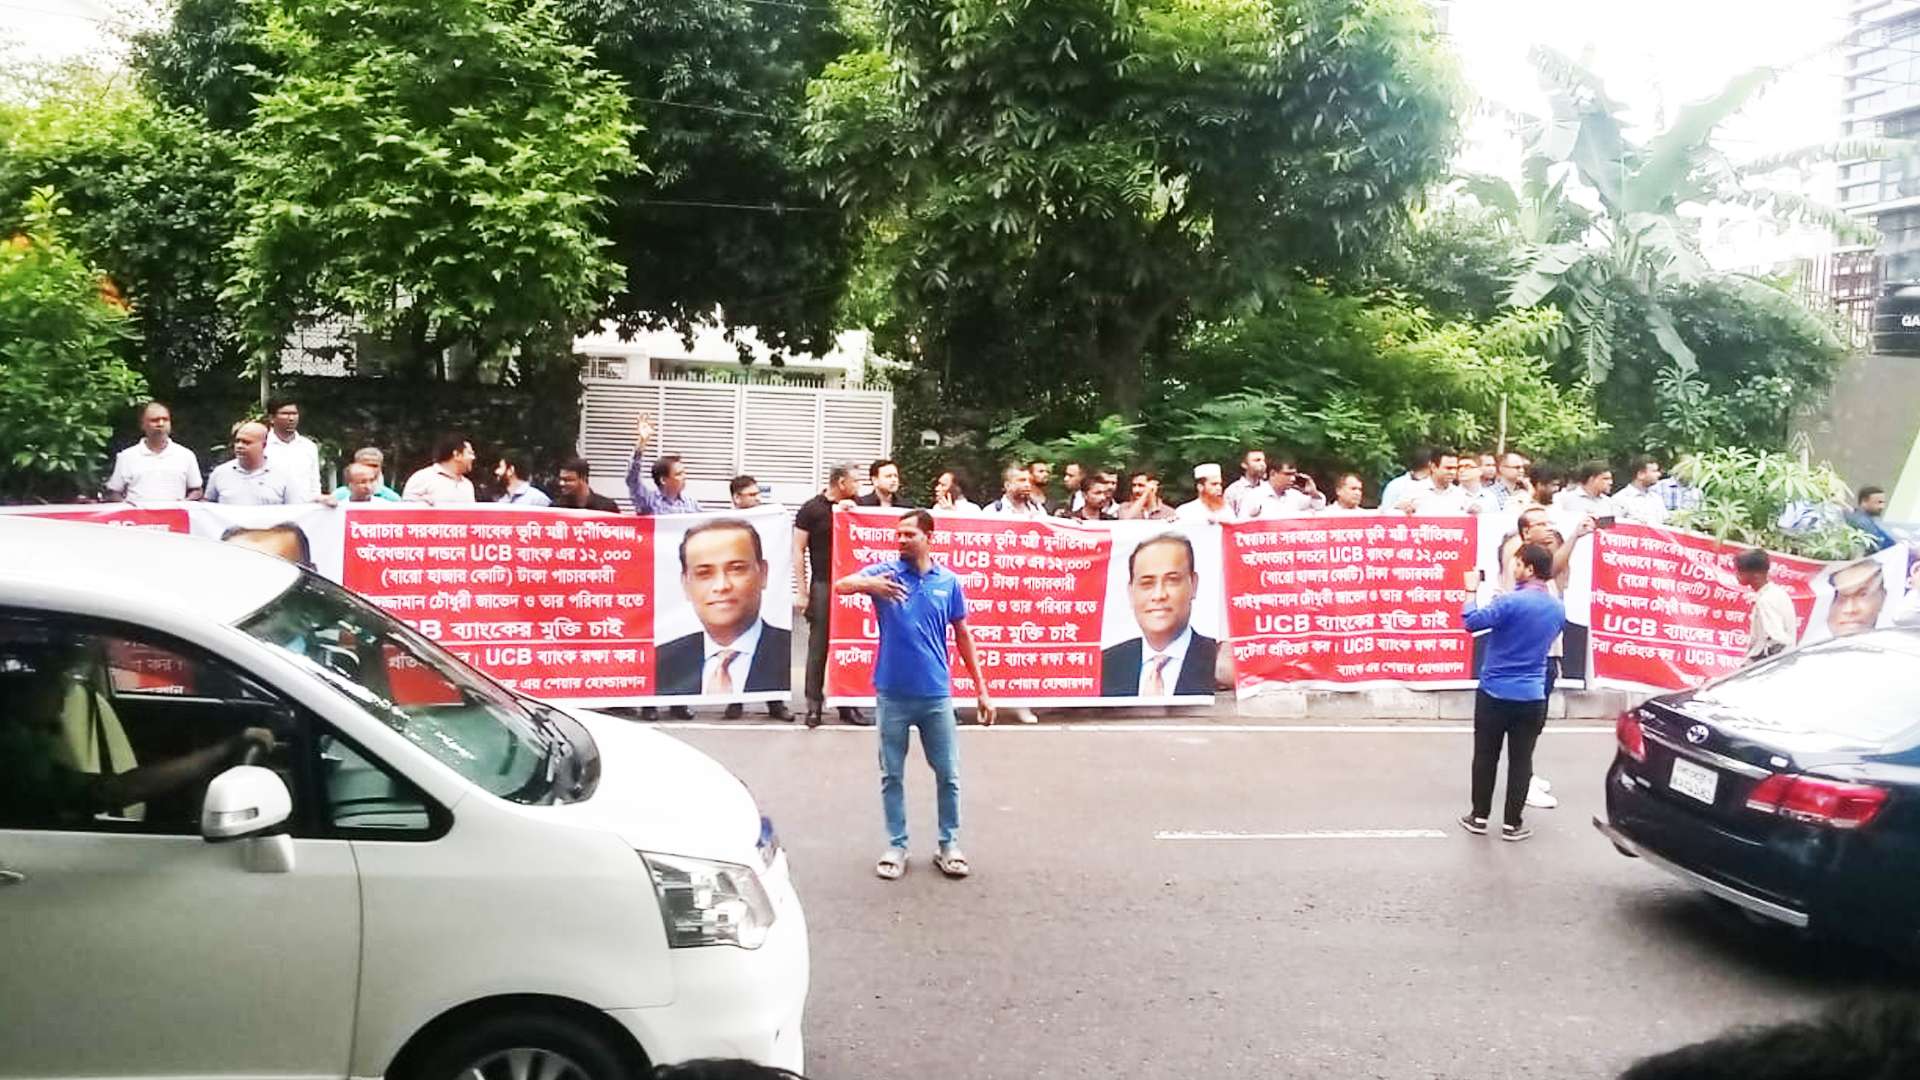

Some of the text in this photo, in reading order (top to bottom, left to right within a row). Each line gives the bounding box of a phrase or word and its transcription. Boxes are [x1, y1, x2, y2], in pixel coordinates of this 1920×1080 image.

[350, 521, 404, 539] স্বৈরাচার
[406, 523, 468, 539] সরকারের
[469, 524, 514, 540] সাবেক
[954, 531, 993, 547] সাবেক
[356, 543, 426, 562] অবৈধভাবে
[470, 543, 513, 561] UCB
[515, 547, 553, 562] ব্যাংক
[556, 547, 577, 560] এর
[579, 548, 632, 564] ১২,০০০
[952, 550, 991, 568] UCB
[993, 555, 1026, 570] ব্যাংক
[1027, 555, 1046, 570] এর
[1329, 546, 1364, 563] UCB
[381, 564, 617, 588] (বারো হাজার কোটি) টাকা পাচারকারী
[992, 572, 1020, 590] টাকা
[1680, 562, 1714, 581] UCB
[474, 594, 521, 610] জাভেদ
[524, 596, 535, 608] ও
[538, 594, 566, 609] তার
[568, 590, 614, 609] পরিবার
[616, 594, 646, 608] হতে
[997, 601, 1008, 613] ও
[450, 621, 534, 640] ব্যাংকের
[538, 617, 583, 641] মুক্তি
[587, 616, 625, 638] চাই
[1255, 609, 1451, 633] UCB ব্যাংকের মুক্তি চাই
[1603, 613, 1657, 636] UCB
[1662, 623, 1715, 642] ব্যাংকের
[1007, 621, 1046, 643] মুক্তি
[1048, 622, 1081, 642] চাই
[1343, 636, 1374, 654] UCB
[486, 647, 533, 666] UCB
[537, 650, 578, 665] ব্যাংক
[580, 649, 610, 664] রক্ষা
[835, 646, 873, 666] লুটেরা
[1004, 652, 1037, 667] ব্যাংক
[1685, 648, 1714, 665] UCB
